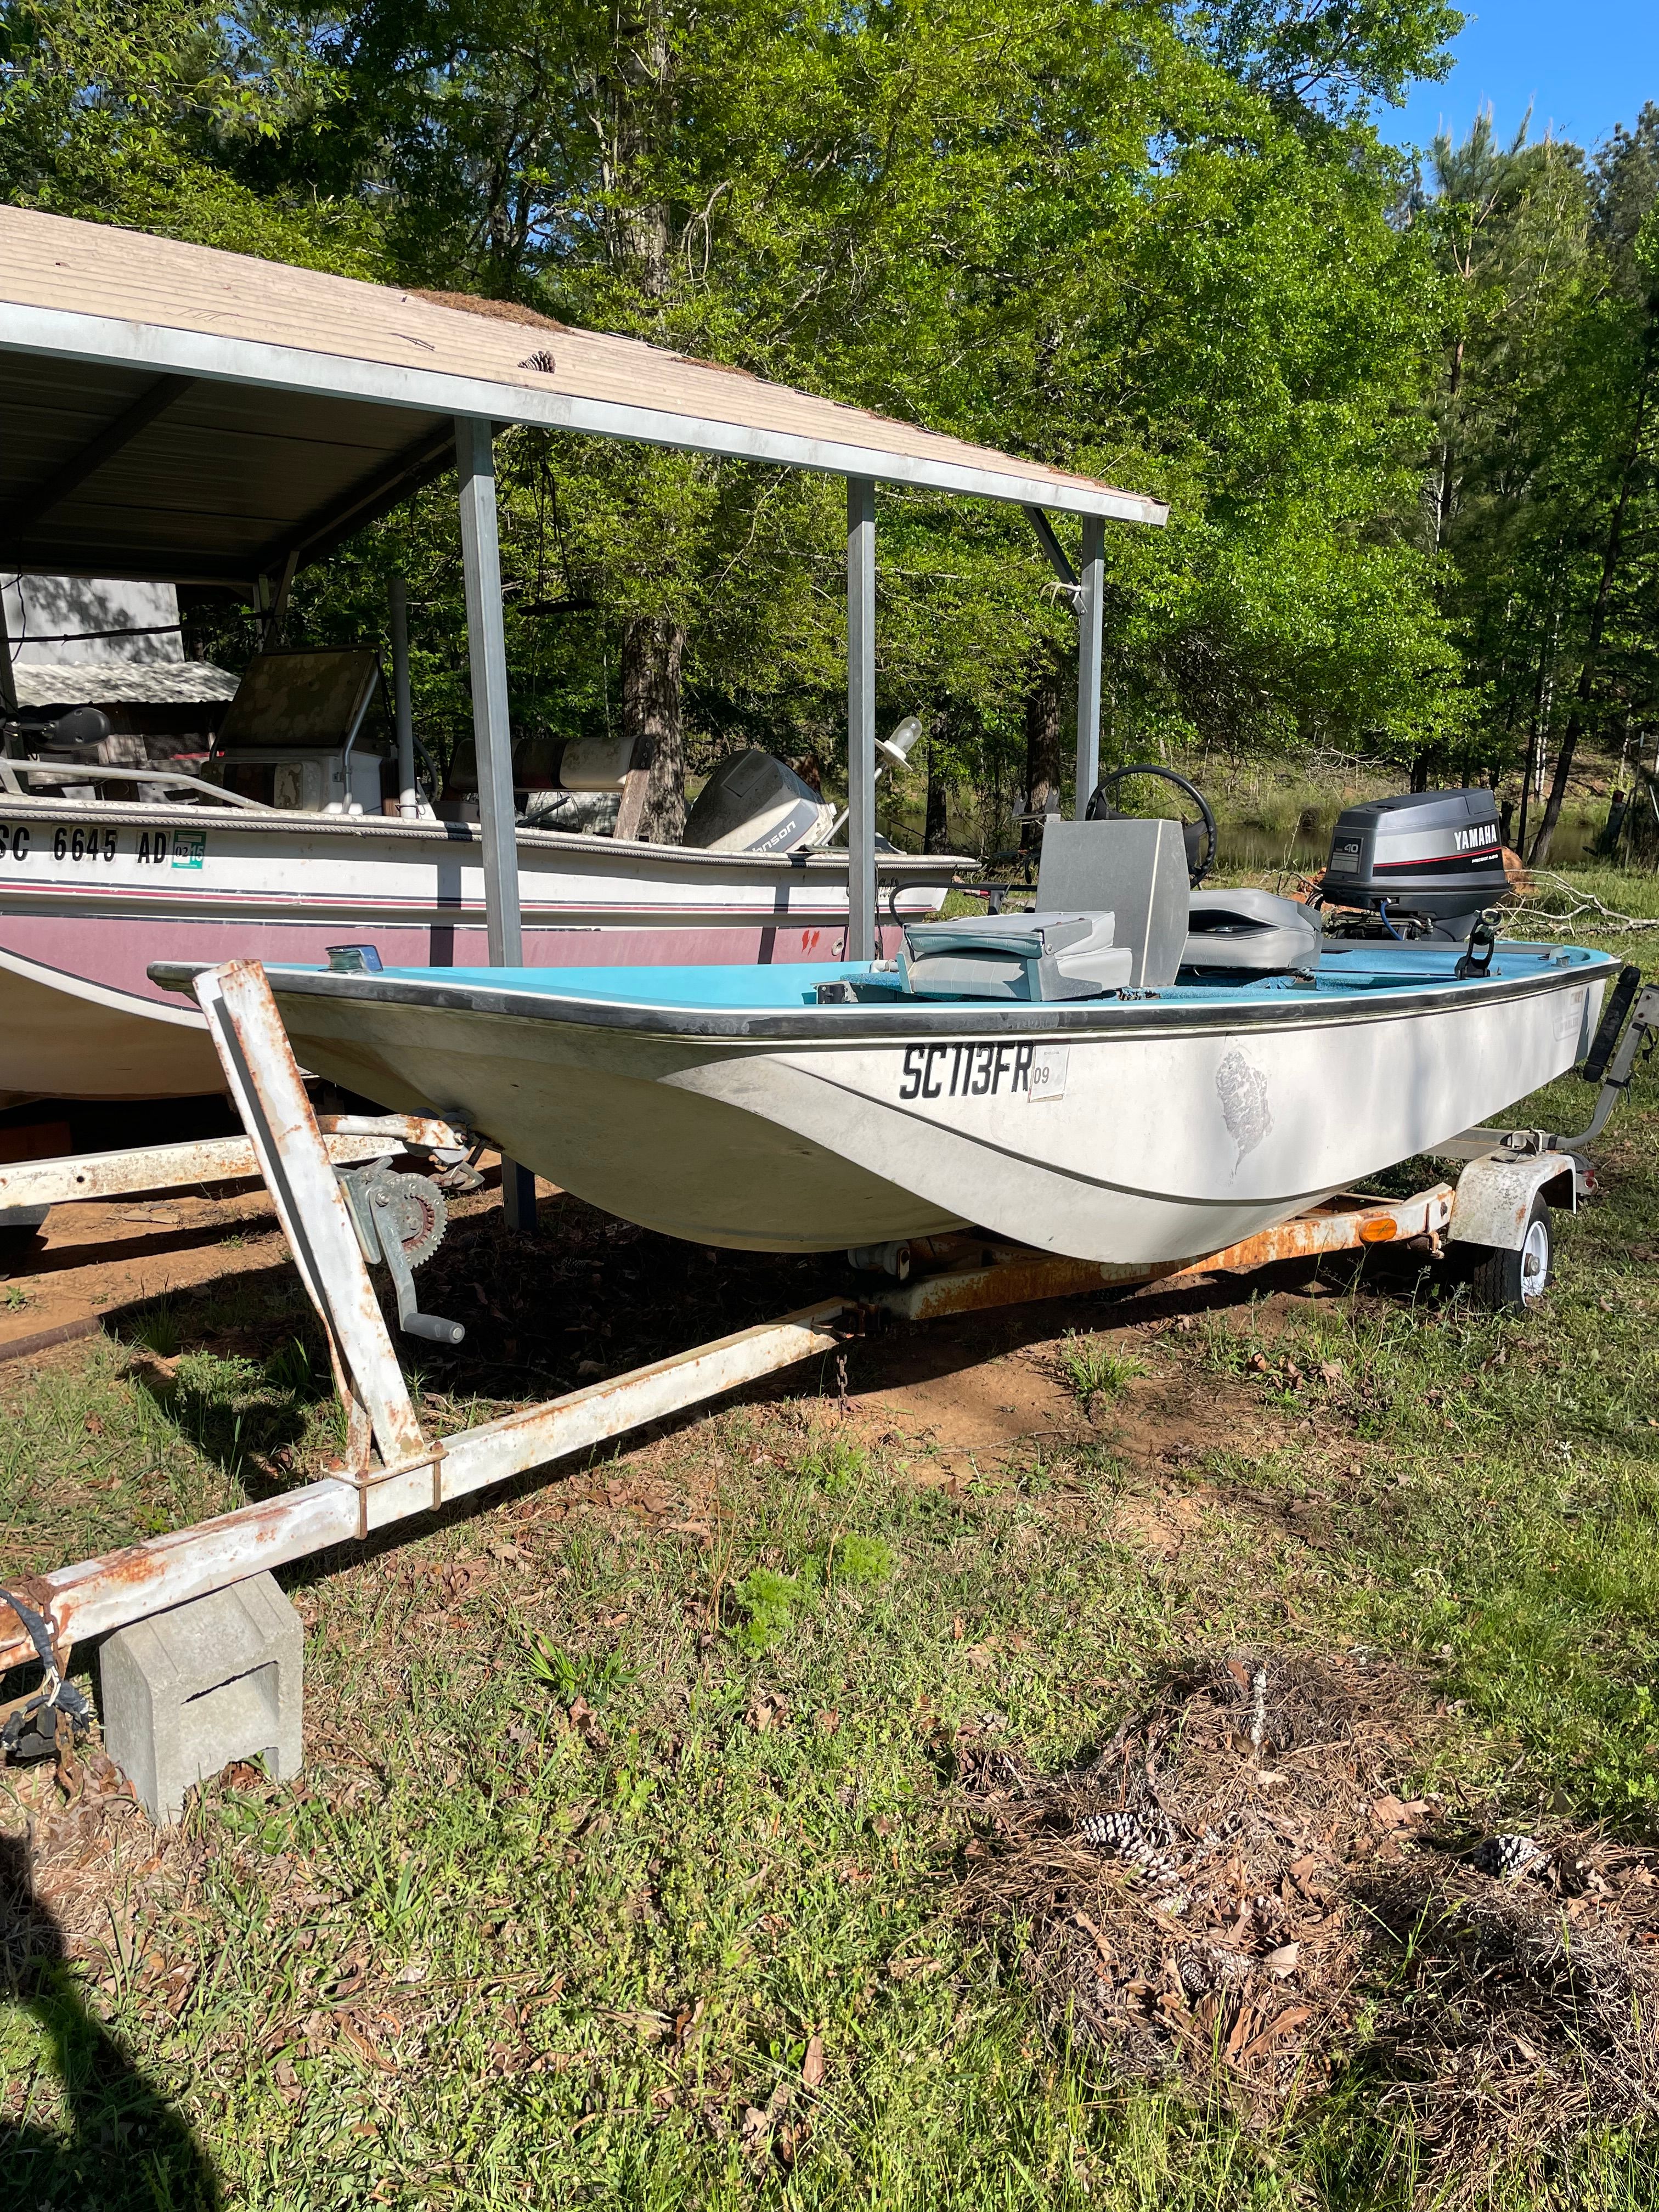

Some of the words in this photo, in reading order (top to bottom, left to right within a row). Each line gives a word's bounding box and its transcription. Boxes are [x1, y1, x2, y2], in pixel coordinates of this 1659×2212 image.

[54, 827, 117, 862] 6645
[137, 832, 166, 864] AD
[752, 821, 796, 852] hnson
[1344, 844, 1359, 853] 40
[1454, 824, 1497, 850] YAMAHA
[176, 847, 188, 857] 02
[191, 845, 204, 861] 15
[899, 1040, 1034, 1099] SC113FR
[1034, 1067, 1049, 1084] 09
